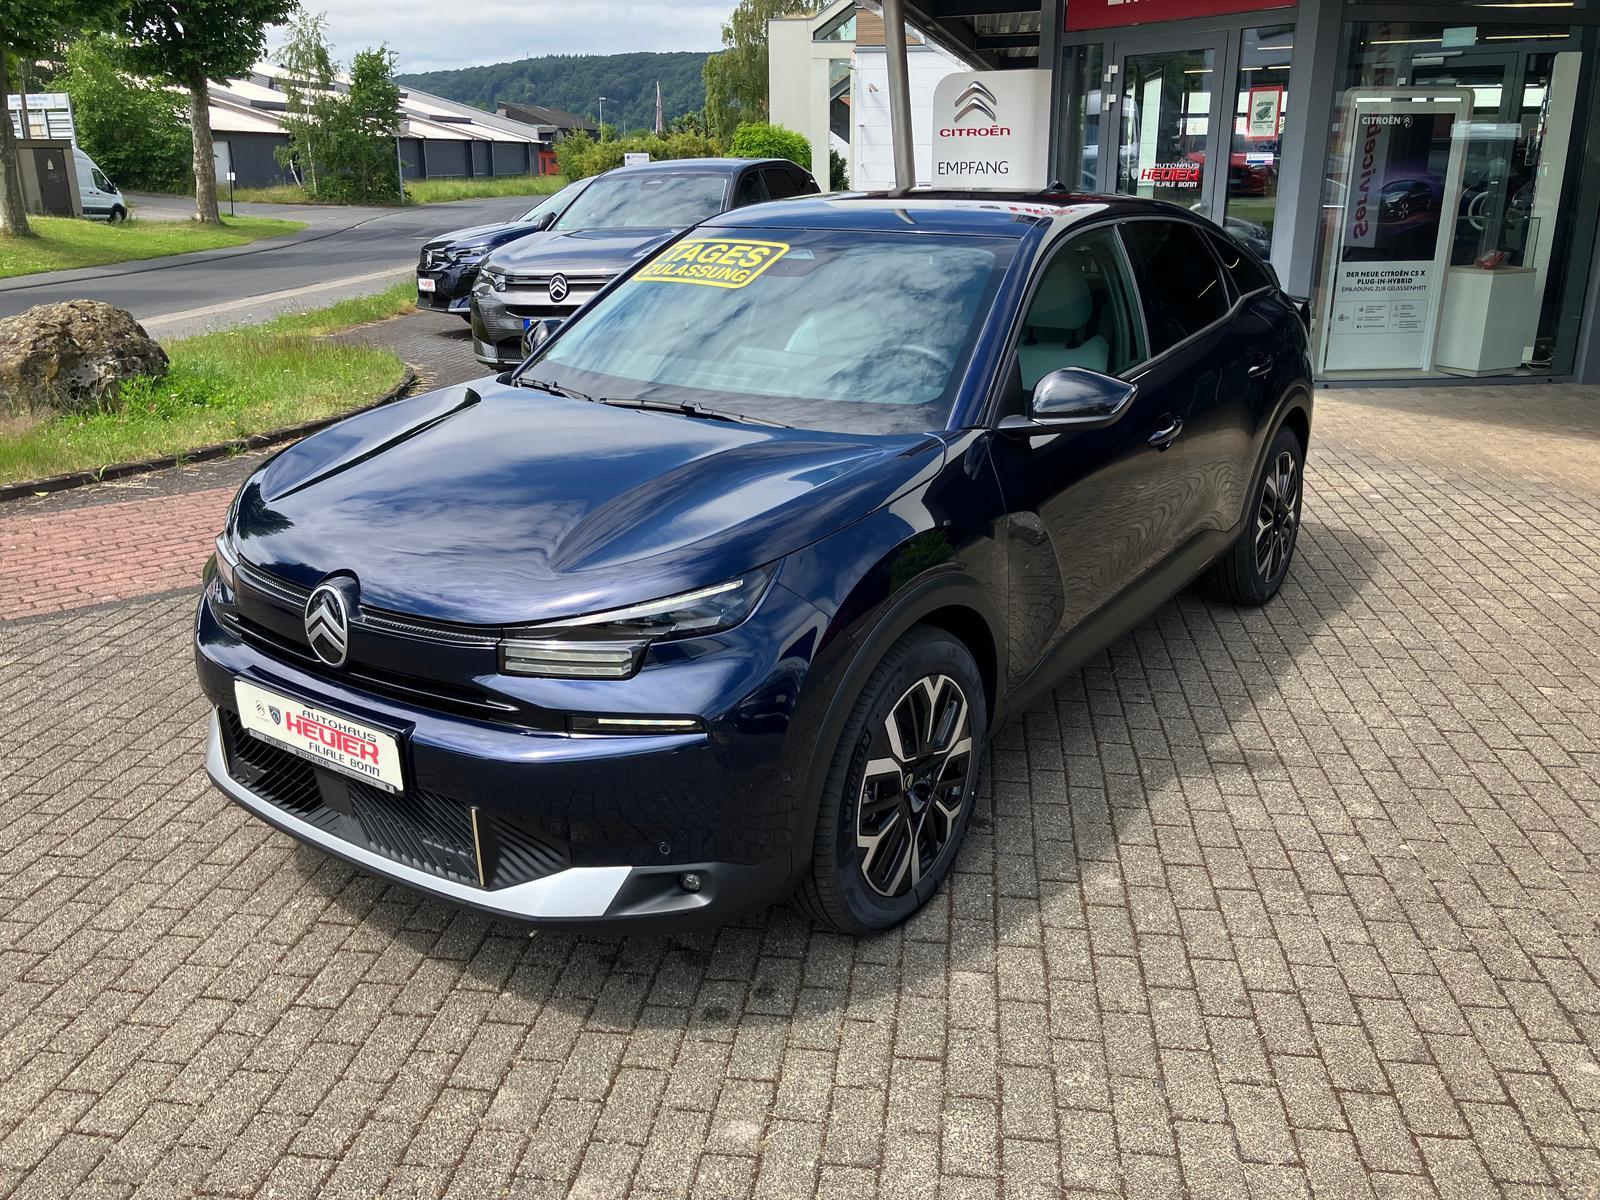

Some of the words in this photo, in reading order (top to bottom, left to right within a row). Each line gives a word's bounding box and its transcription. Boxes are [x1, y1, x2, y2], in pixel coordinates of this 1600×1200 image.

[1361, 116, 1401, 125] CITROËN
[937, 160, 1009, 175] EMPFANG
[1140, 168, 1200, 180] HEUTER
[664, 244, 770, 267] TAGES
[645, 264, 750, 282] ZULASSUNG
[302, 709, 377, 743] AUTOHAUS
[285, 711, 379, 765] HEUTER
[308, 741, 345, 763] FILIALE
[350, 758, 380, 777] BONN
